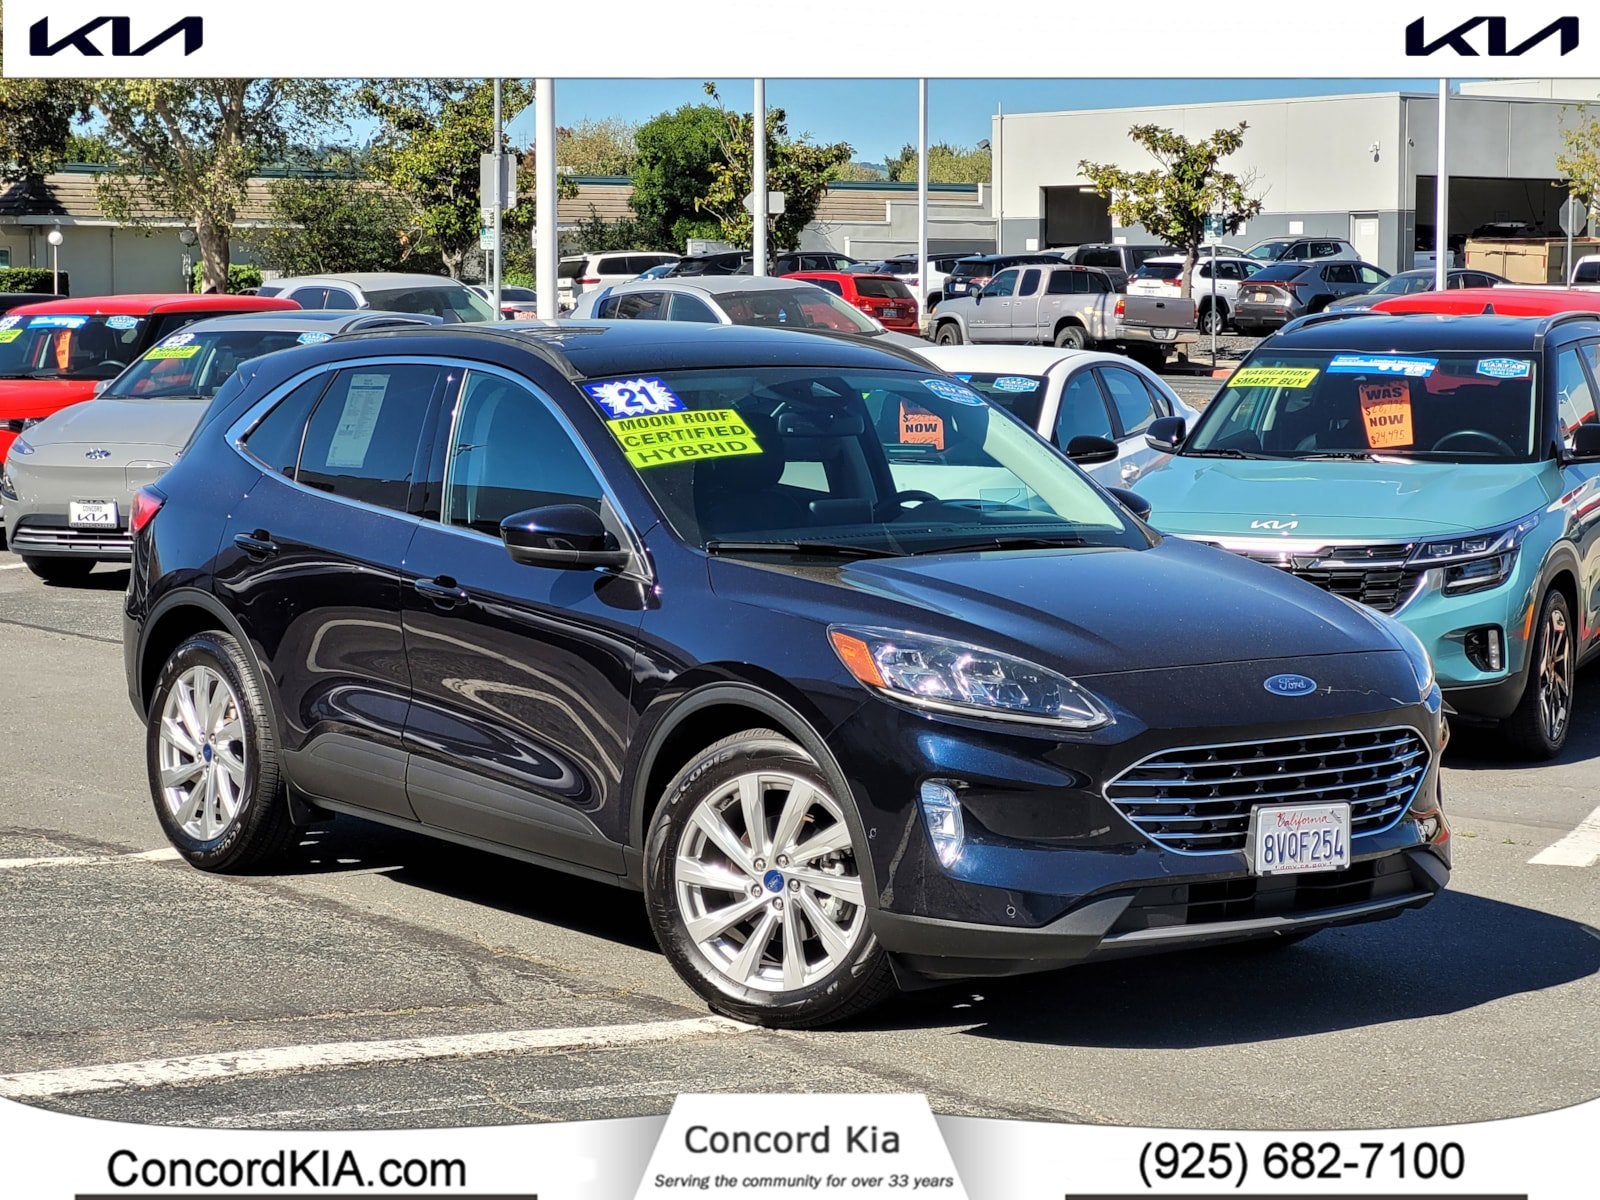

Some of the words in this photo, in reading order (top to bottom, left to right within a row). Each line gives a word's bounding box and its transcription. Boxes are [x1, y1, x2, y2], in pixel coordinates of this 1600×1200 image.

[617, 385, 658, 408] 21
[1366, 387, 1403, 400] WAS
[618, 414, 676, 432] MOON
[683, 411, 730, 425] ROOF
[905, 423, 937, 433] NOW
[1369, 414, 1404, 427] NOW
[624, 425, 746, 448] CERTIFIED
[637, 440, 748, 463] HYBRID
[1276, 811, 1330, 830] California
[1264, 829, 1344, 864] 8VQF254
